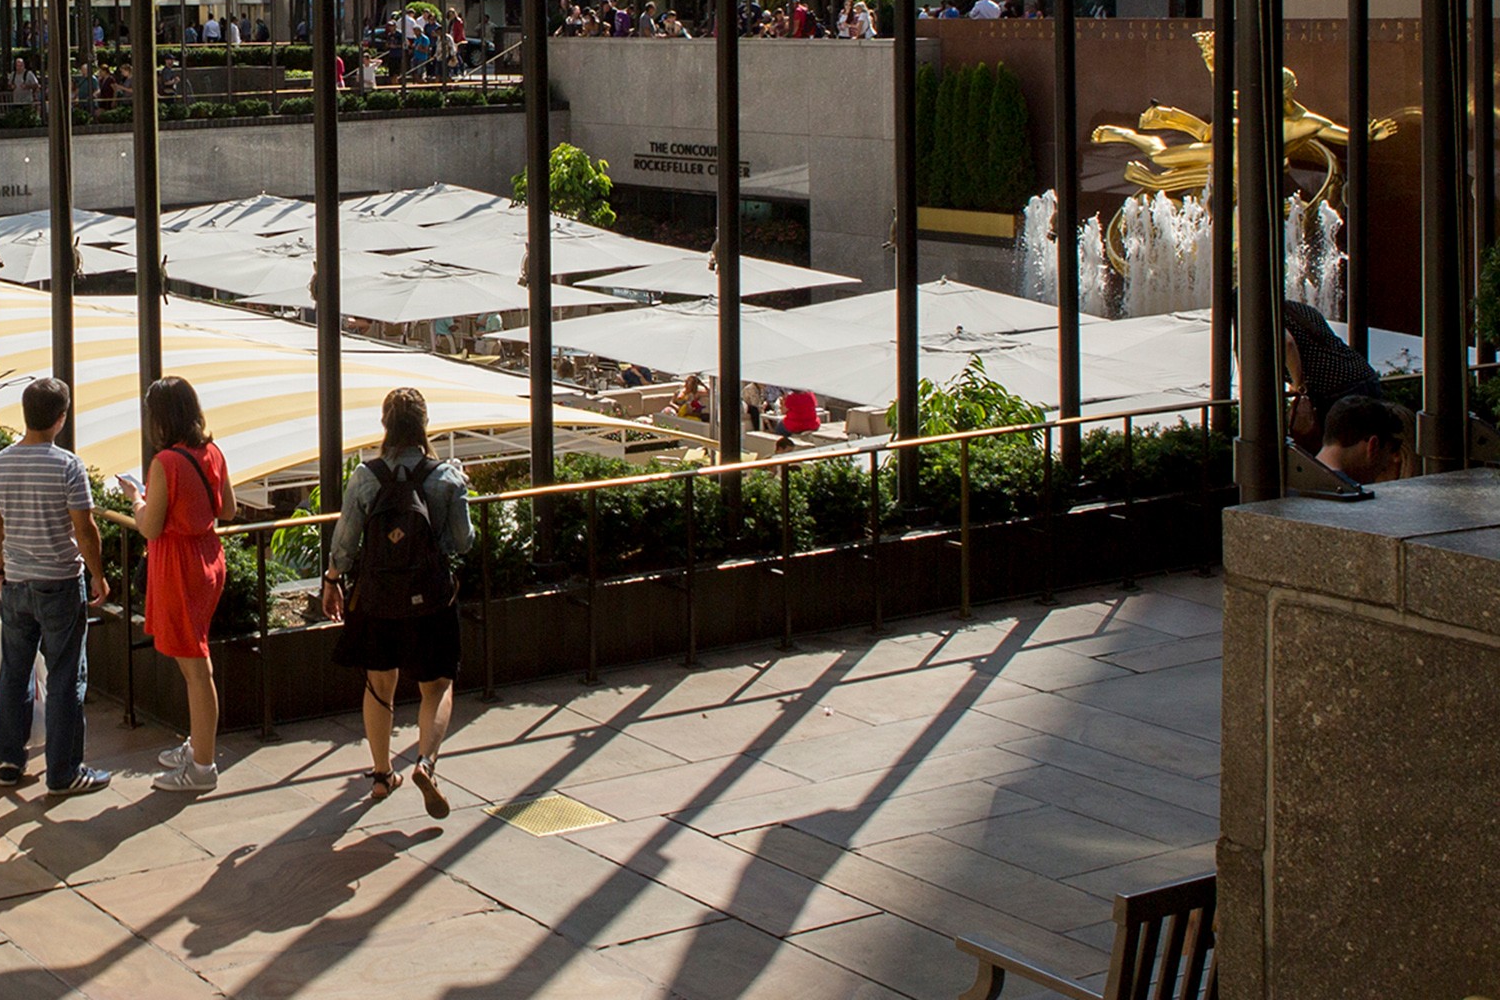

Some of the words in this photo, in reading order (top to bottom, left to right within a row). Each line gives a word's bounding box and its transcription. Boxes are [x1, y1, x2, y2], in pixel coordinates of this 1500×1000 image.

[649, 141, 668, 154] THE
[670, 143, 718, 157] CONCOU
[633, 159, 704, 175] ROCKEFELLER
